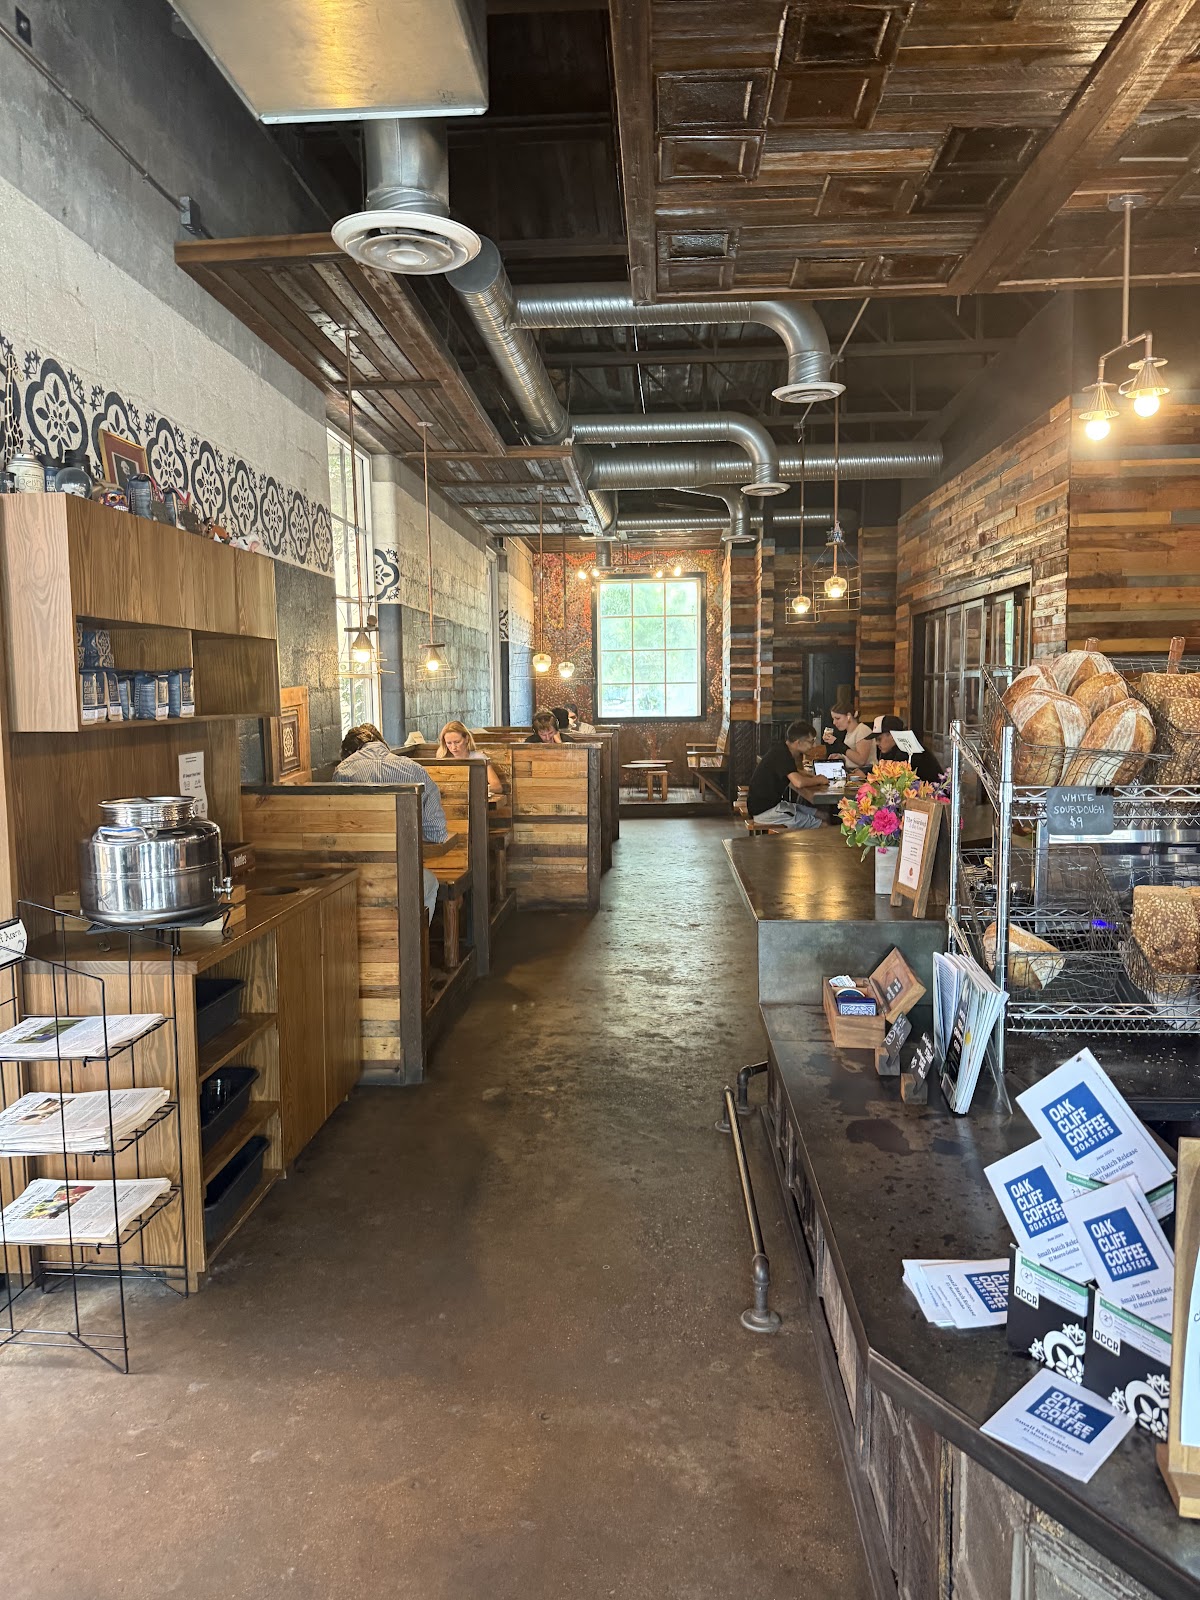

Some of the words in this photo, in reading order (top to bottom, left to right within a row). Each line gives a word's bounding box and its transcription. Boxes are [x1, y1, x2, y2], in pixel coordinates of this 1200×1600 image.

[1054, 804, 1104, 814] SOURDOUGH
[1062, 794, 1094, 802] WHITE
[1070, 816, 1083, 828] $9
[1049, 1098, 1075, 1122] OAK
[1057, 1107, 1087, 1134] CLIFF
[1066, 1113, 1109, 1147] COFFEE
[1073, 1127, 1114, 1154] ROASTERS
[1101, 1159, 1117, 1171] Batch
[1116, 1148, 1138, 1162] Release
[1010, 1178, 1034, 1198] OAK
[1016, 1189, 1043, 1212] CLIFF
[1023, 1198, 1061, 1224] COFFEE
[1029, 1211, 1066, 1232] ROASTERS
[1090, 1218, 1116, 1239] OAK
[1037, 1247, 1051, 1258] Small
[1050, 1242, 1066, 1254] Batch
[1098, 1232, 1127, 1252] CLIFF
[1105, 1242, 1147, 1267] COFFEE
[1111, 1257, 1152, 1276] ROASTERS
[971, 1277, 998, 1309] ROASTERS
[979, 1275, 1009, 1308] COFFEE
[1016, 1286, 1037, 1306] OCCR
[1121, 1294, 1136, 1304] Small
[1136, 1290, 1152, 1300] Batch
[1152, 1286, 1172, 1296] Release
[1095, 1330, 1119, 1352] OCCR
[1045, 1398, 1086, 1420] CLIFF
[1051, 1391, 1084, 1410] OAK
[1034, 1409, 1087, 1439] ROASTERS
[1039, 1404, 1094, 1435] COFFEE
